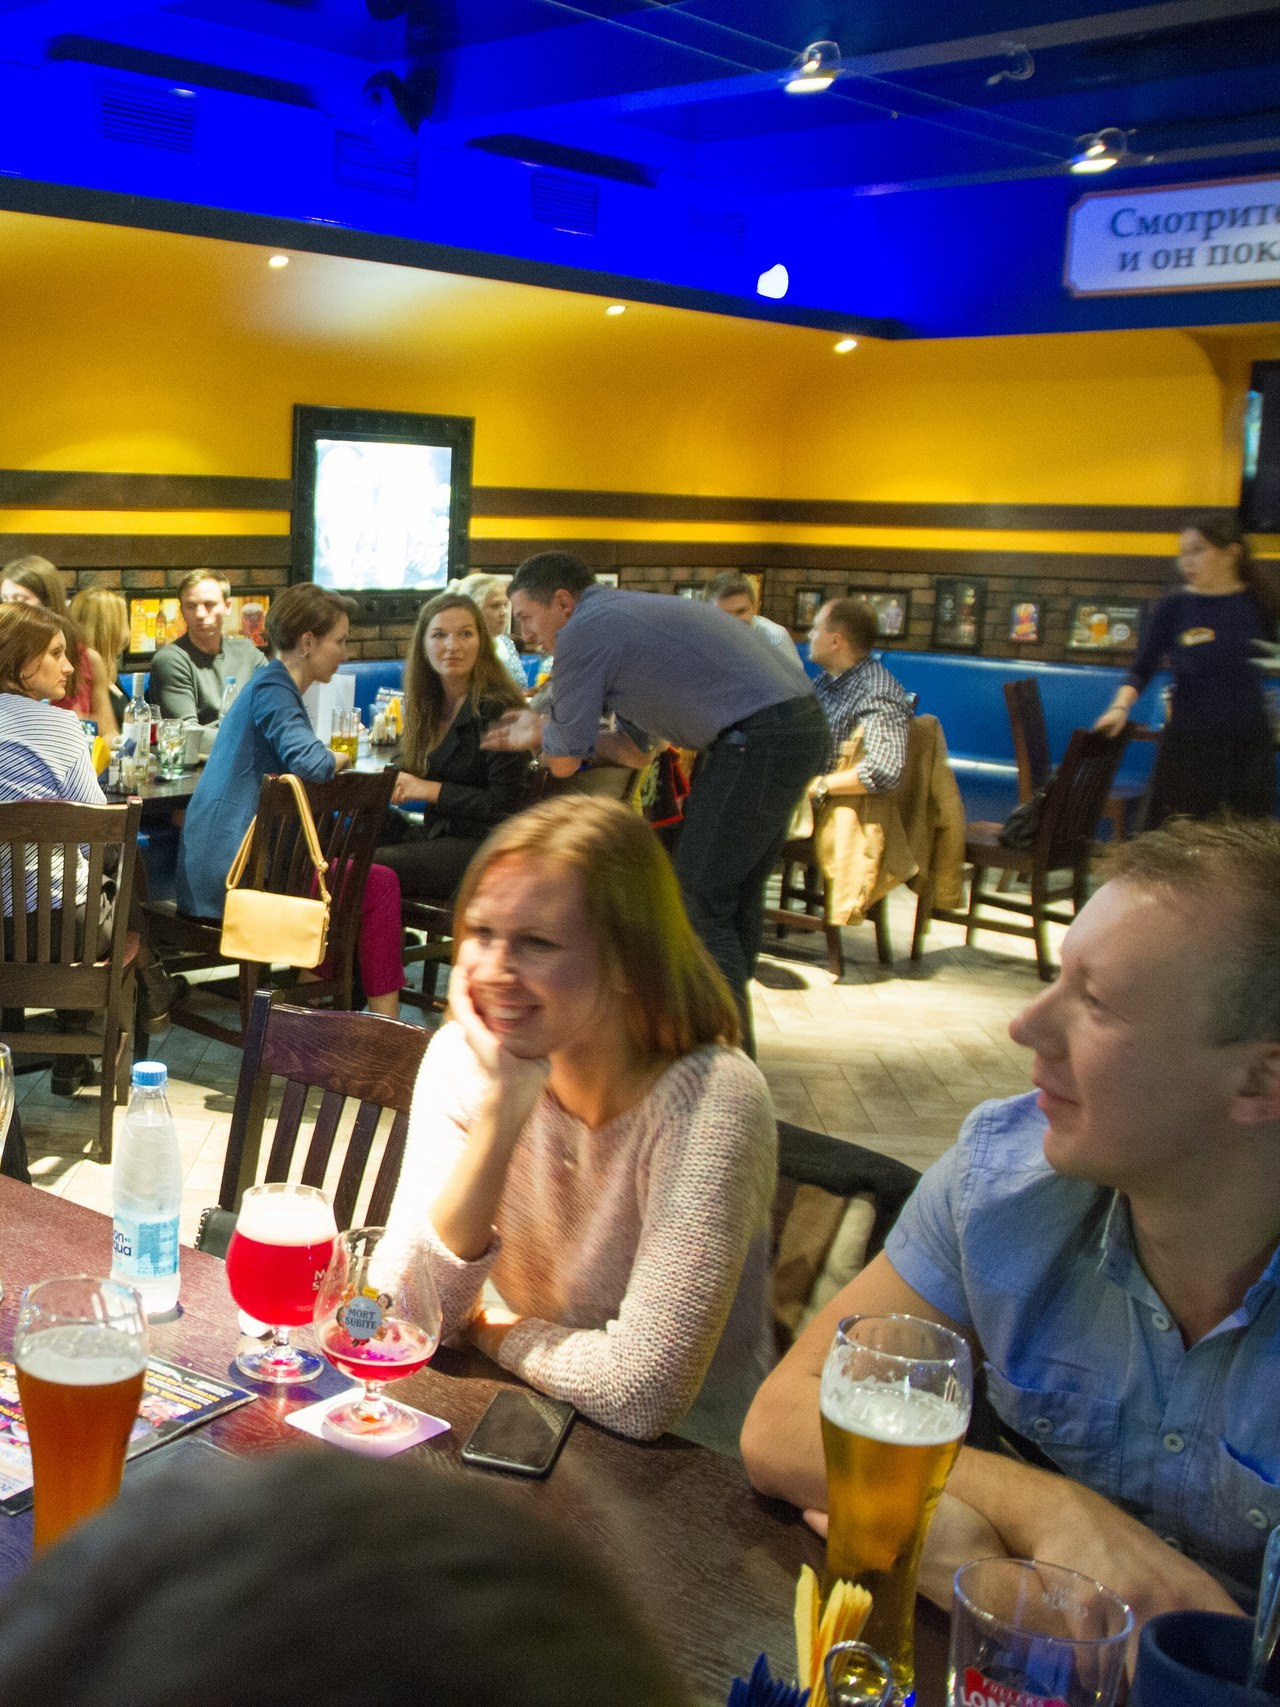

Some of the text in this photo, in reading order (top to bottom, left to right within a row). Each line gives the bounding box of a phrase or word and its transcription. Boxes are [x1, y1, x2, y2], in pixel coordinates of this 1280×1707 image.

[1119, 239, 1280, 272] и он пок
[348, 1307, 377, 1320] MORT
[344, 1316, 377, 1330] SUBITE
